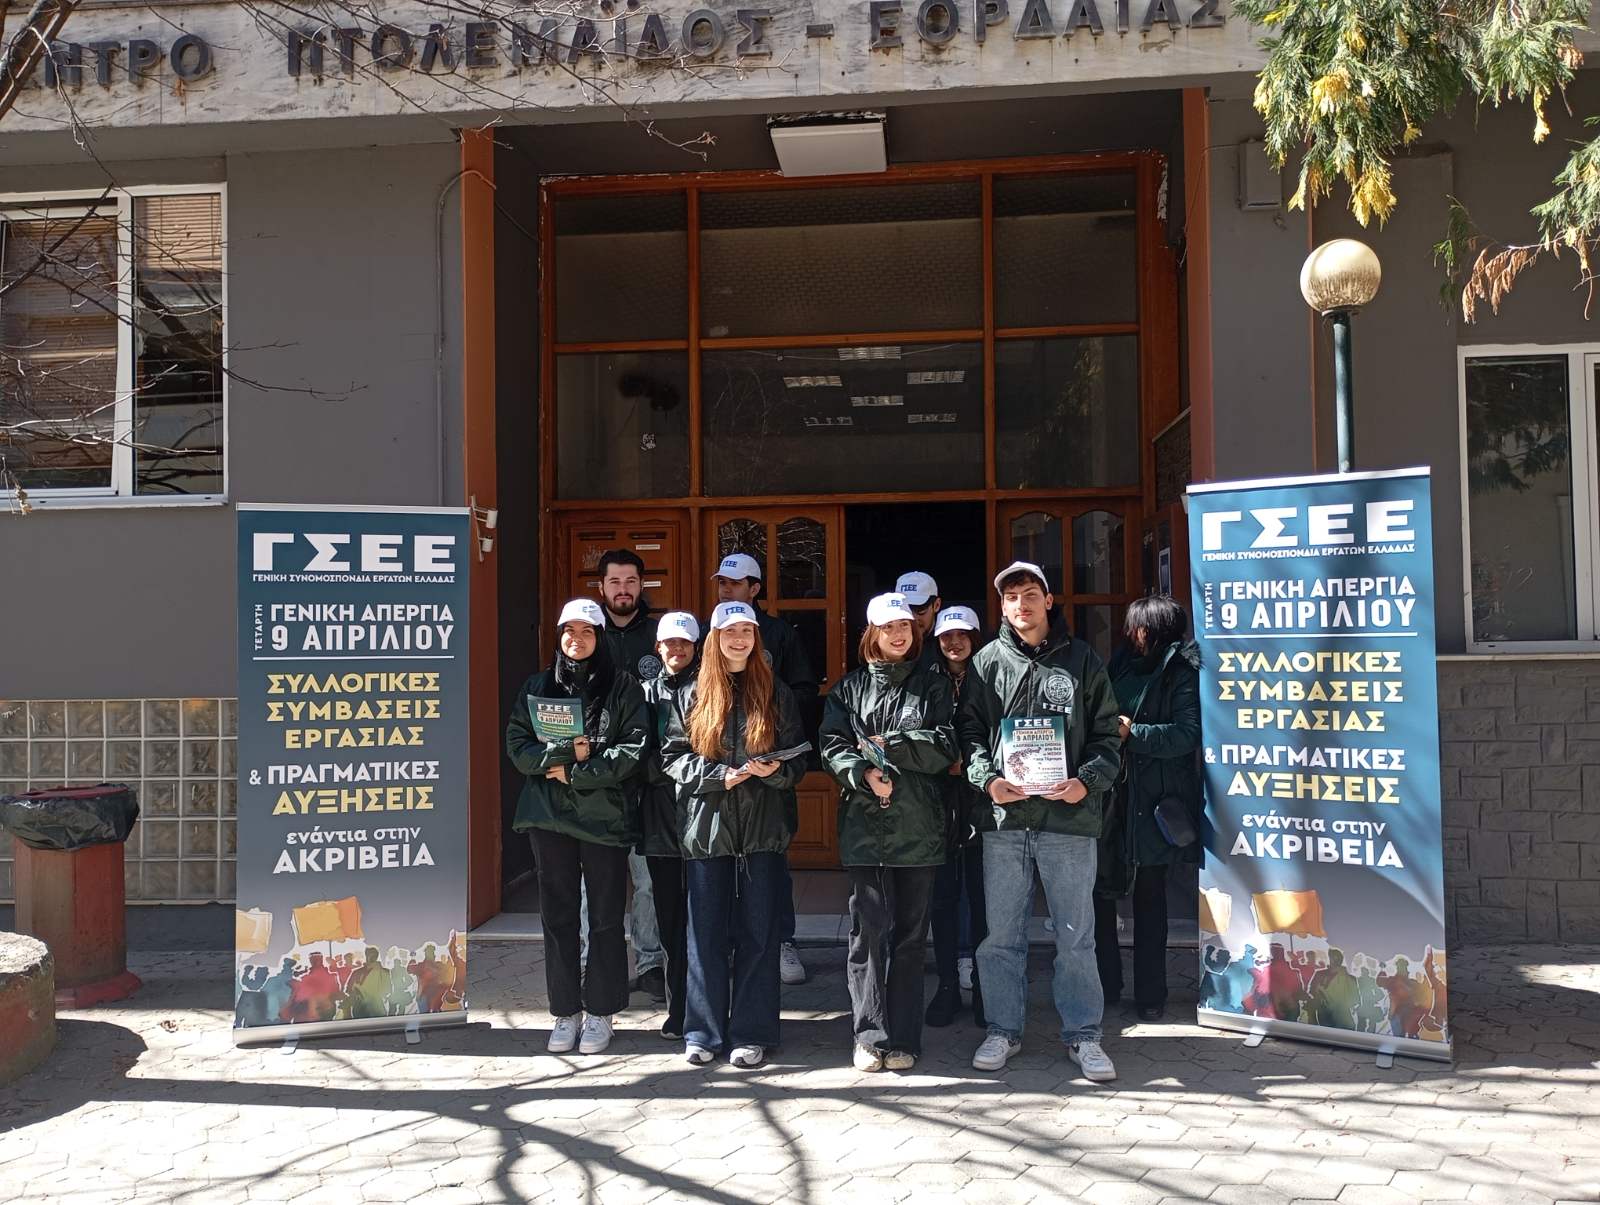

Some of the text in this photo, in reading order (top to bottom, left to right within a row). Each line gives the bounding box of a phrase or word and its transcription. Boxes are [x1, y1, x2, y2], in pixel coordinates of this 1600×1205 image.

[806, 24, 834, 38] -
[1202, 499, 1415, 551] ΓΣΕΕ
[253, 532, 456, 573] ΓΣΕΕ
[1202, 543, 1415, 562] ΓΕΝΙΚΗ ΣΥΝΟΜΟΣΠΟΝΔΙΑ ΕΡΓΑΤΩΝ ΕΛΛΑΔΑΣ
[253, 573, 455, 583] ΓΕΝΙΚΗ ΣΥΝΟΜΟΣΠΟΝΔΙΑ ΕΡΓΑΤΩΝ ΕΛΛΑΔΑΣ
[1220, 575, 1416, 600] ΓΕΝΙΚΗ ΑΠΕΡΓΙΑ
[270, 603, 454, 622] ΓΕΝΙΚΗ ΑΠΕΡΓΙΑ
[1204, 582, 1214, 630] ΤΕΤΑΡΤΗ
[1220, 598, 1416, 629] 9 ΑΠΡΙΛΙΟΥ
[254, 604, 263, 651] ΤΕΤΑΡΤΗ
[271, 624, 454, 651] 9 ΑΠΡΙΛΙΟΥ
[1218, 651, 1402, 673] ΣΥΛΛΟΓΙΚΕΣ
[267, 672, 440, 694] ΣΥΛΛΟΓΙΚΕΣ
[1218, 680, 1404, 703] ΣΥΜΒΑΣΕΙΣ
[266, 699, 441, 722] ΣΥΜΒΑΣΕΙΣ
[1014, 718, 1052, 727] ΓΣΕΕ
[1237, 708, 1385, 732] ΕΡΓΑΣΙΑΣ
[285, 726, 424, 749] ΕΡΓΑΣΙΑΣ
[1204, 744, 1405, 770] & ΠΡΑΓΜΑΤΙΚΕΣ
[248, 760, 440, 785] & ΠΡΑΓΜΑΤΙΚΕΣ
[1227, 771, 1400, 804] ΑΥΞΗΣΕΙΣ
[272, 786, 434, 816] ΑΥΞΗΣΕΙΣ
[286, 825, 421, 845] ενάντια στην
[1242, 810, 1386, 839] ενάντια στην
[272, 842, 435, 874] ΑΚΡΙΒΕΙΑ
[1229, 831, 1404, 869] ΑΚΡΙΒΕΙΑ
